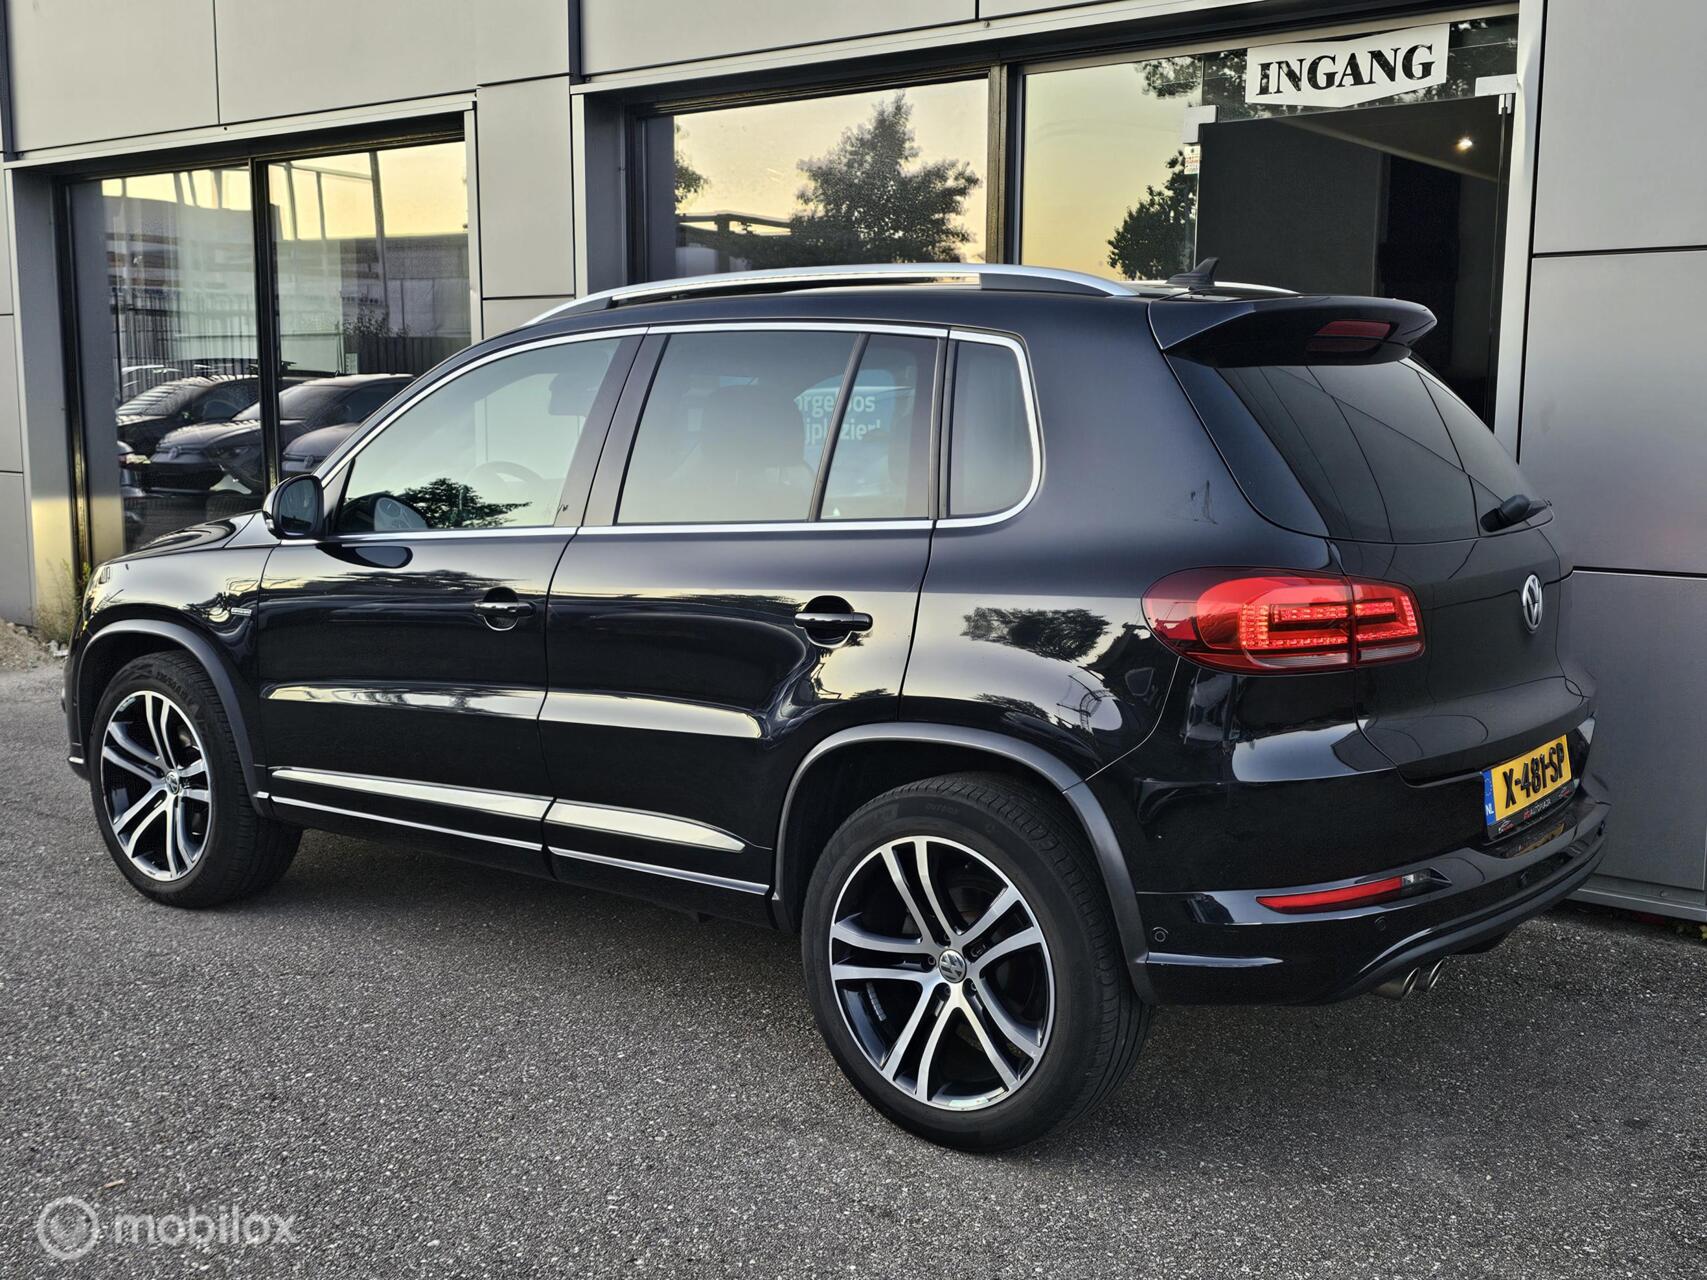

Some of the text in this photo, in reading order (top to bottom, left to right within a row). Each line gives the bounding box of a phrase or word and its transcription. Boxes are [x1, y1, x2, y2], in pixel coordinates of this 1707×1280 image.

[1256, 43, 1435, 96] INGANG
[1502, 742, 1565, 809] X-481-SP
[1484, 802, 1495, 817] NL
